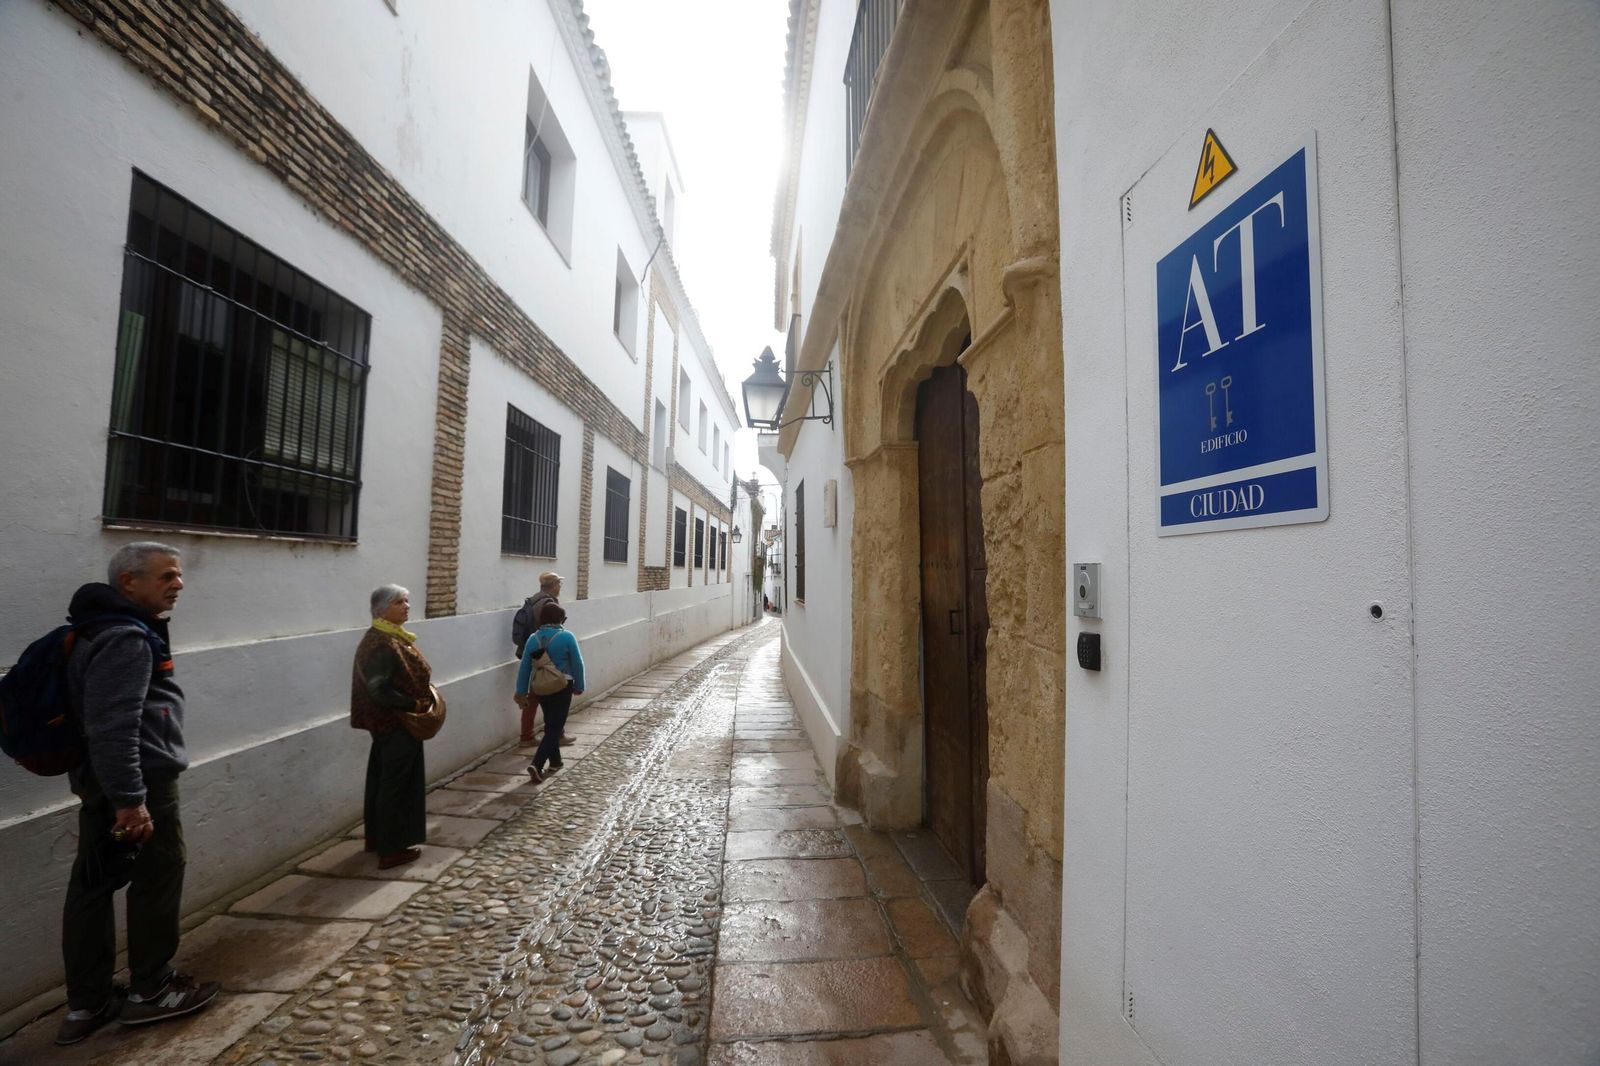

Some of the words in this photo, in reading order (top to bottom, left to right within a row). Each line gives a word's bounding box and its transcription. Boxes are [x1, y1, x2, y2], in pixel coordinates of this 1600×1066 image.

[1171, 190, 1285, 373] AT
[1200, 429, 1247, 454] EDIFICIO
[1190, 484, 1265, 518] CIUDAD
